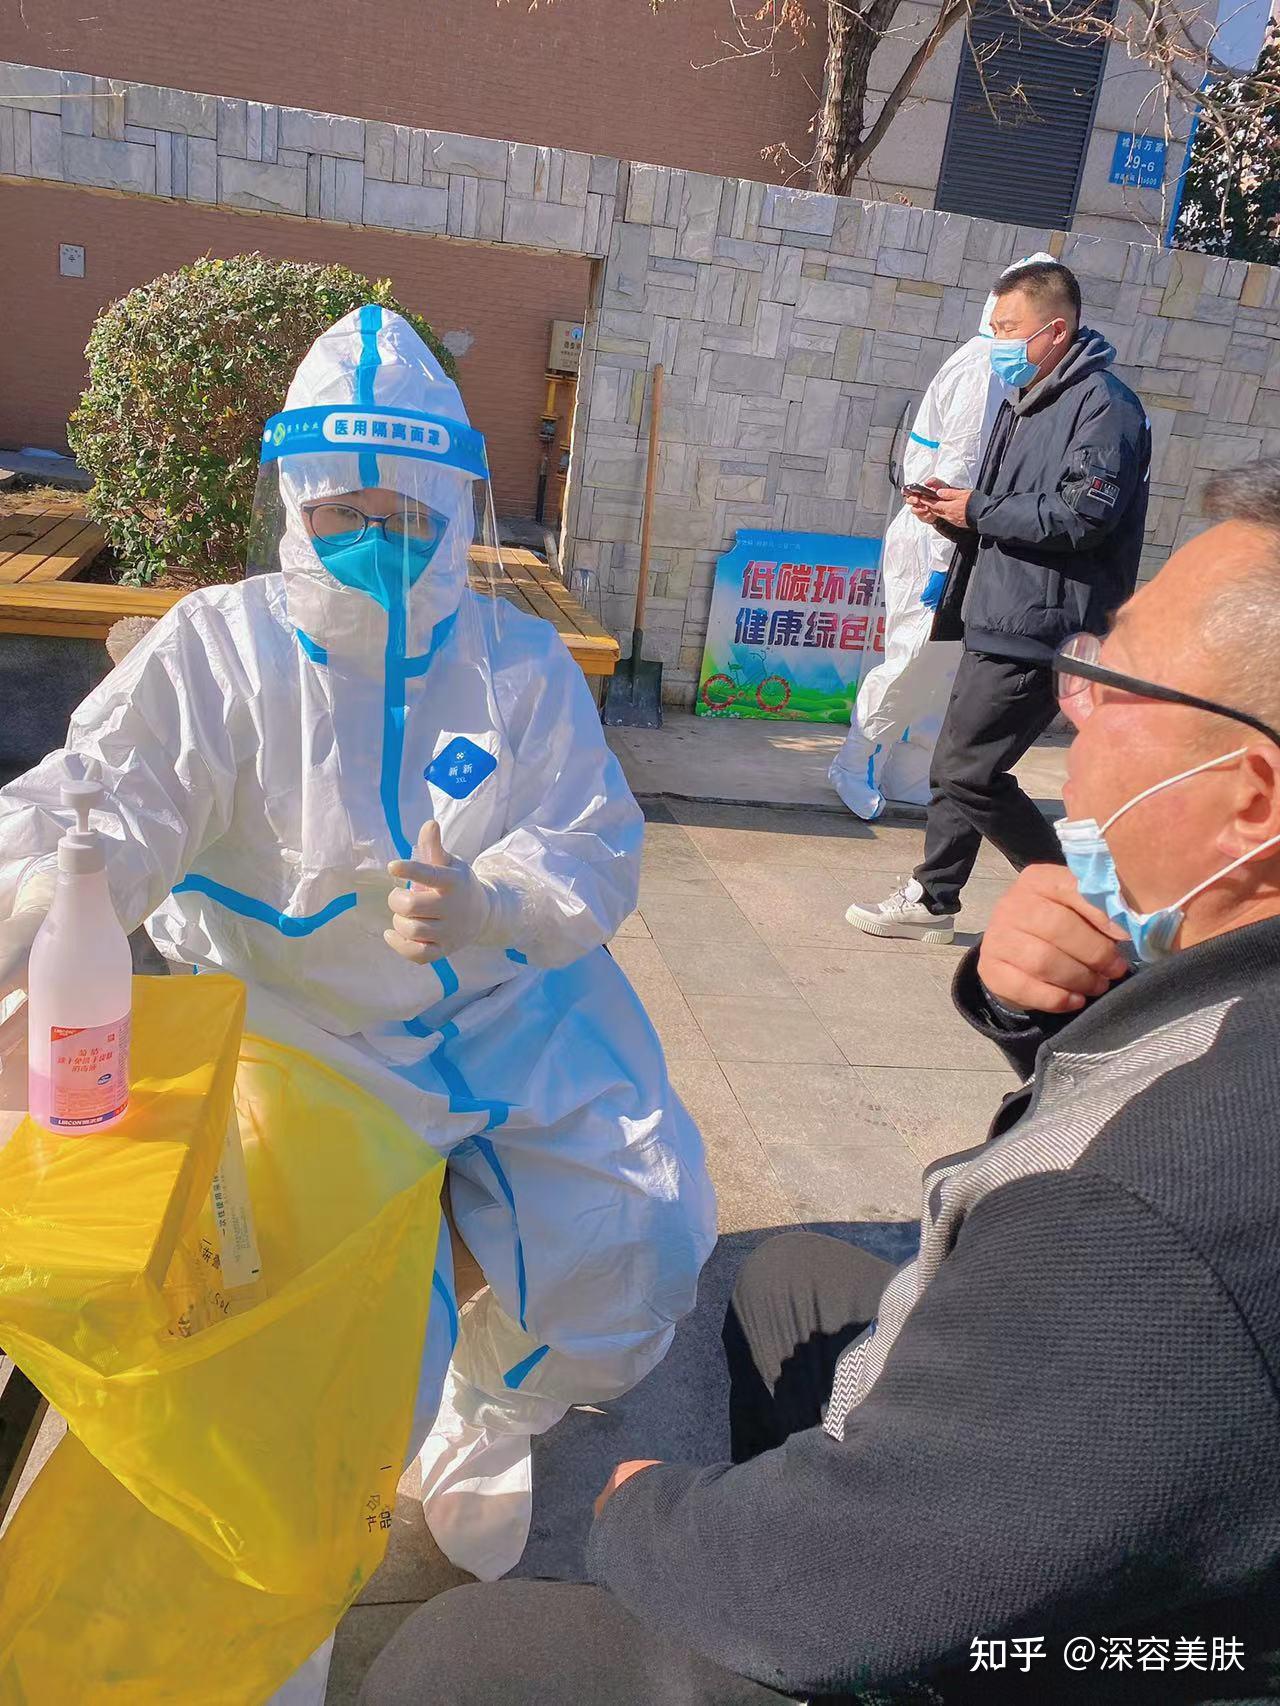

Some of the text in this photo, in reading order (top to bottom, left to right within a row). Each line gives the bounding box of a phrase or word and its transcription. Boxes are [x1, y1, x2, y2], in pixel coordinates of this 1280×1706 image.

[334, 419, 441, 447] 医用隔离面罩
[742, 560, 885, 608] 低碳环保
